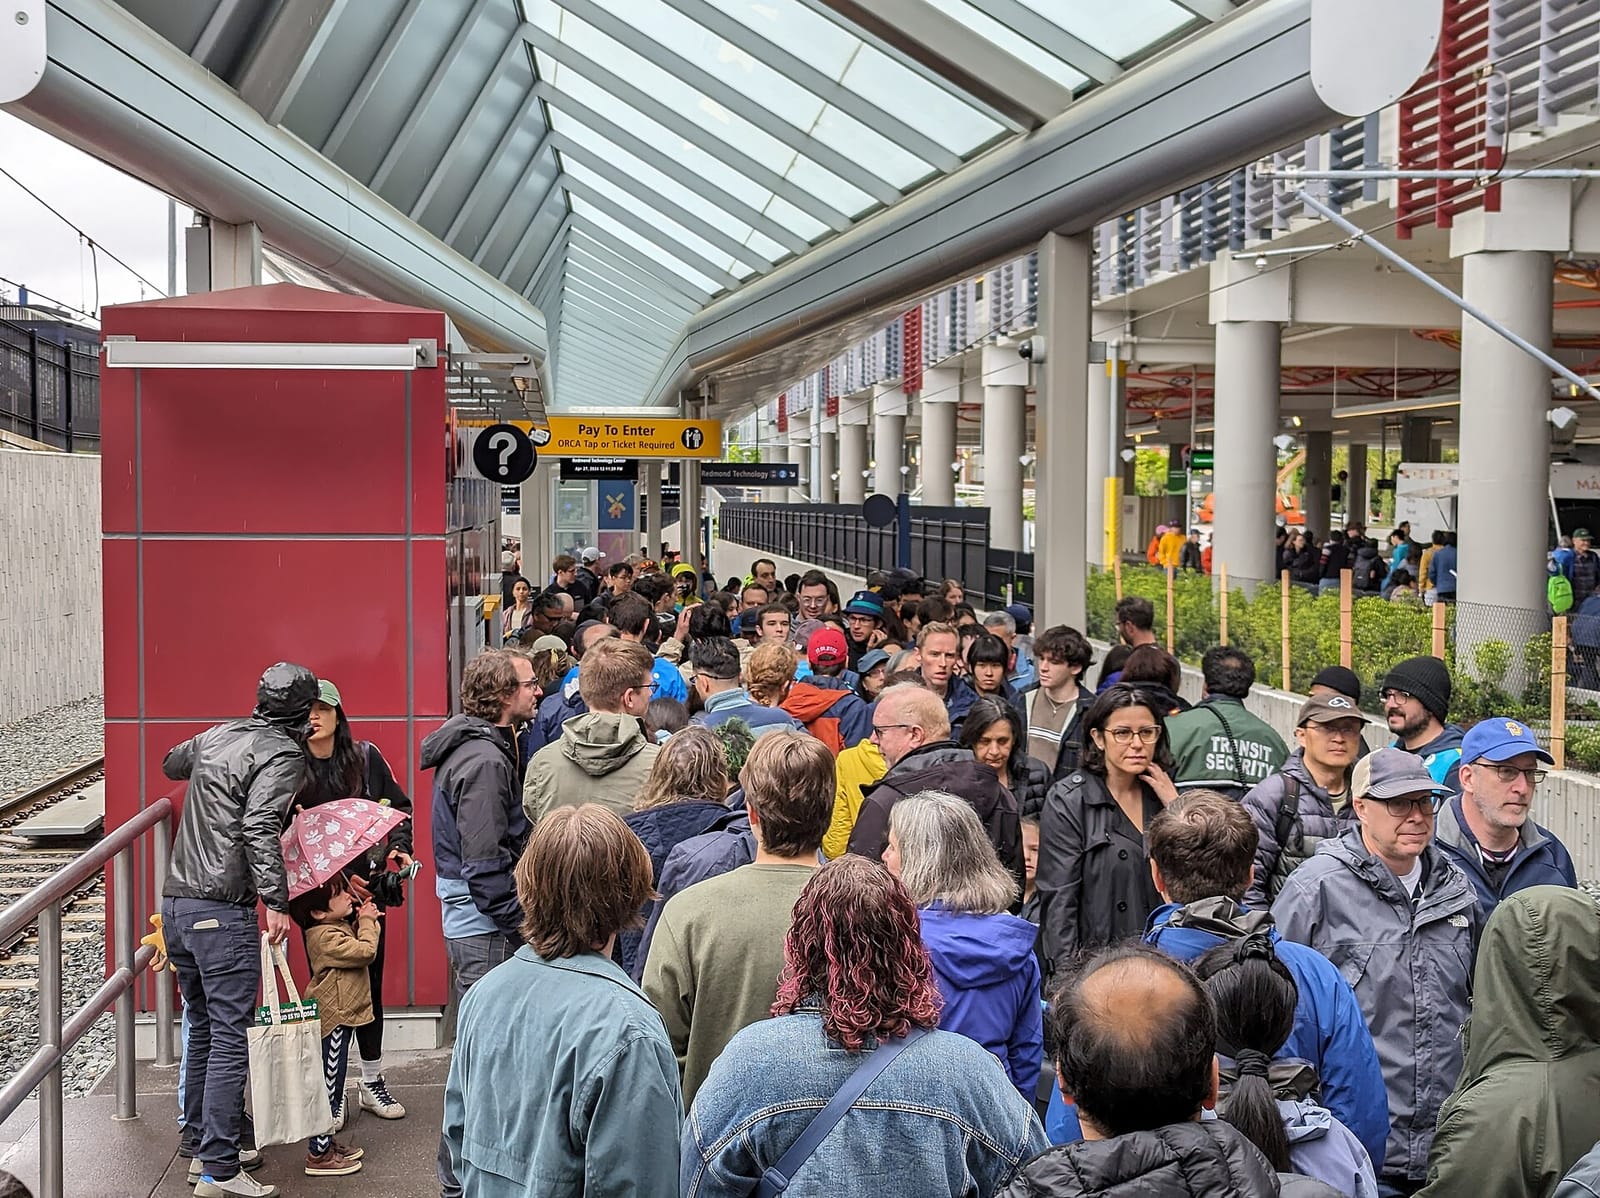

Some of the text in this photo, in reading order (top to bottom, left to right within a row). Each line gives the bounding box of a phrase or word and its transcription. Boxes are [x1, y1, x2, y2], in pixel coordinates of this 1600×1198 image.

[578, 424, 656, 438] Pay To Enter
[558, 439, 581, 448] ORCA
[584, 440, 598, 450] Tap
[613, 440, 636, 449] Ticket
[639, 440, 675, 450] Required
[701, 469, 731, 477] Redmond
[732, 469, 768, 479] Technology
